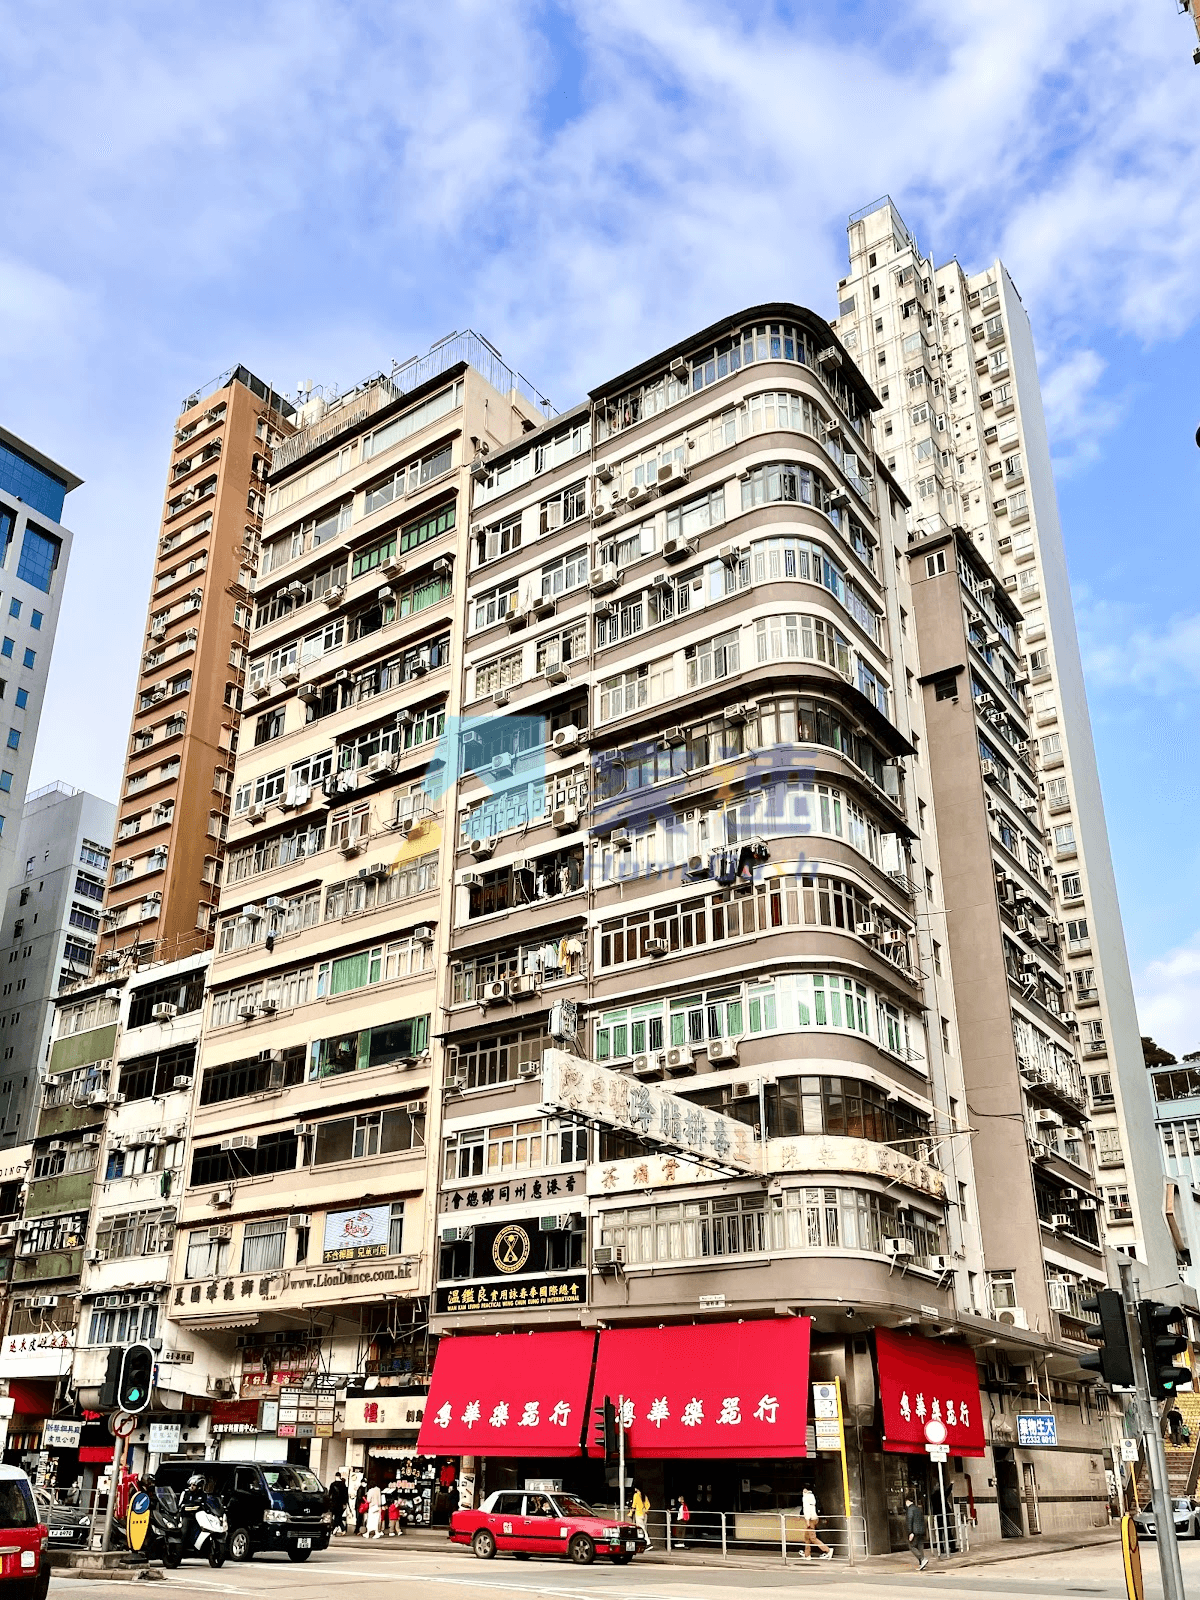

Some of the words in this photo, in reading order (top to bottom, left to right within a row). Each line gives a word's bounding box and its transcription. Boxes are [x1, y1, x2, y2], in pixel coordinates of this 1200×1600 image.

[452, 1175, 576, 1210] 香港惠州同鄉總會
[290, 1266, 412, 1289] www.LionDance.com.hk
[547, 1295, 580, 1304] INTERNATIONAL
[48, 1435, 76, 1445] 有限公司
